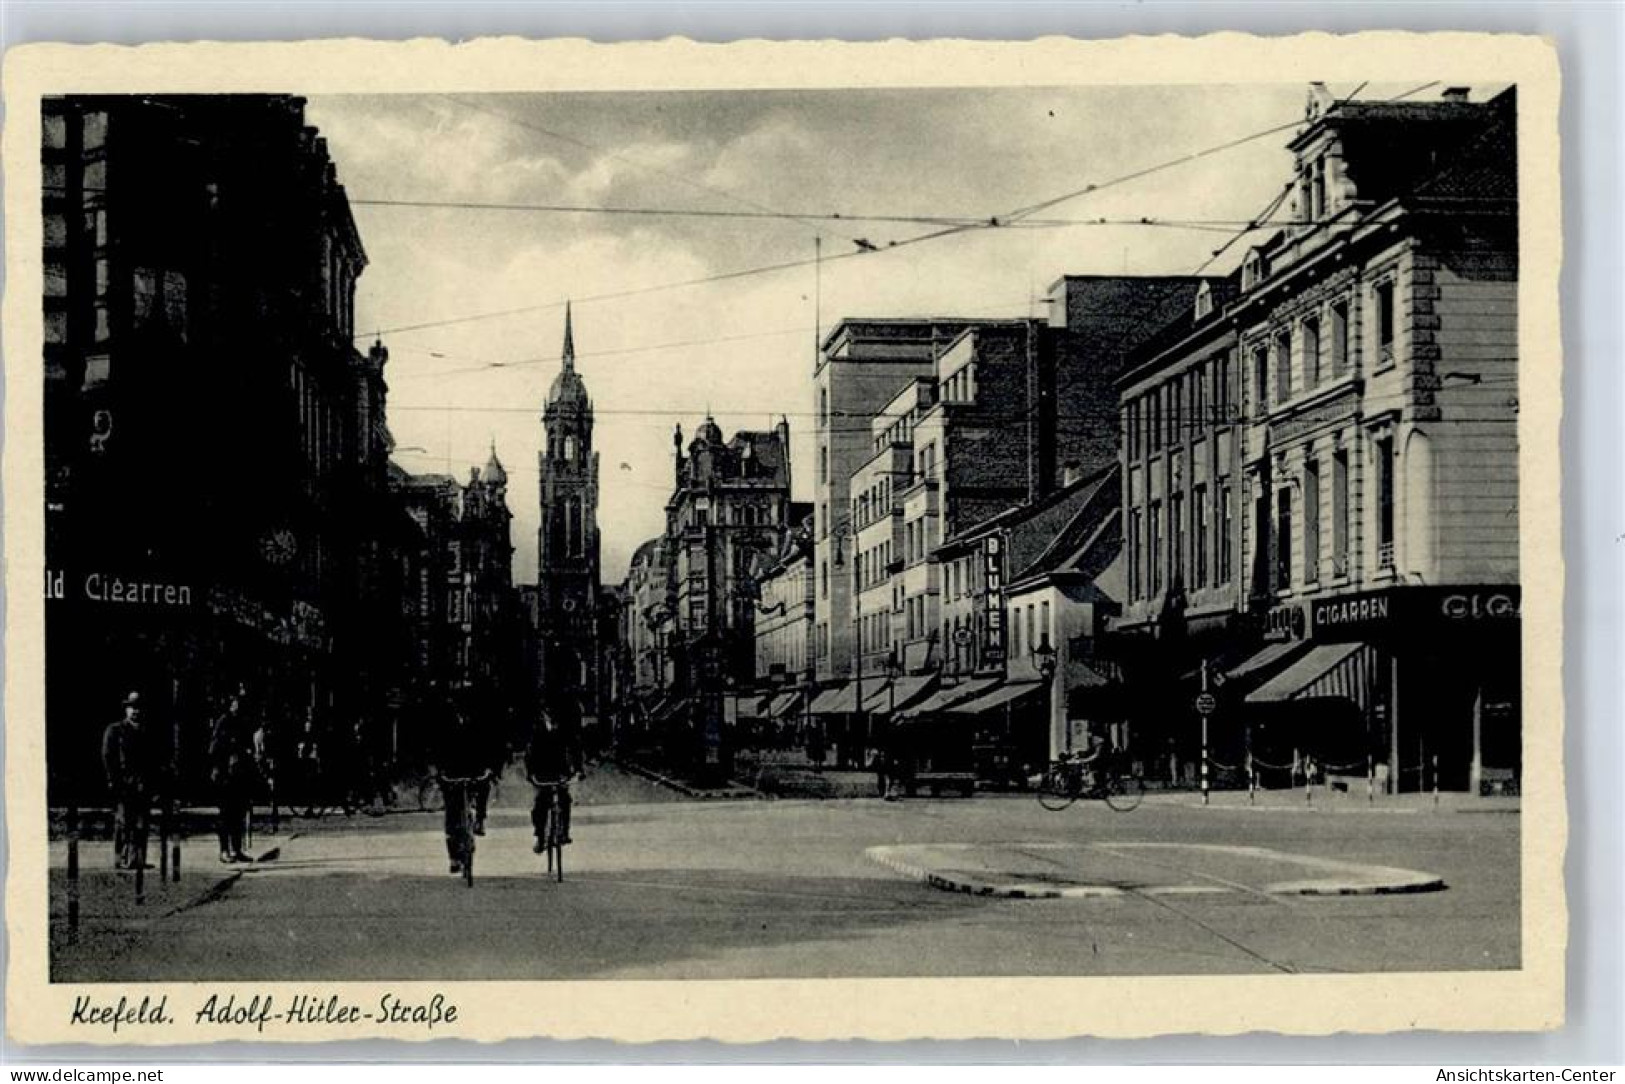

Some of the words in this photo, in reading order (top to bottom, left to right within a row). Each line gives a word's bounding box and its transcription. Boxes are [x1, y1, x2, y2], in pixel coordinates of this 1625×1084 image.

[84, 573, 191, 605] Cigarren
[988, 537, 1001, 647] BLUMEN
[1315, 596, 1389, 625] CIGARREN
[1442, 594, 1521, 619] CIG
